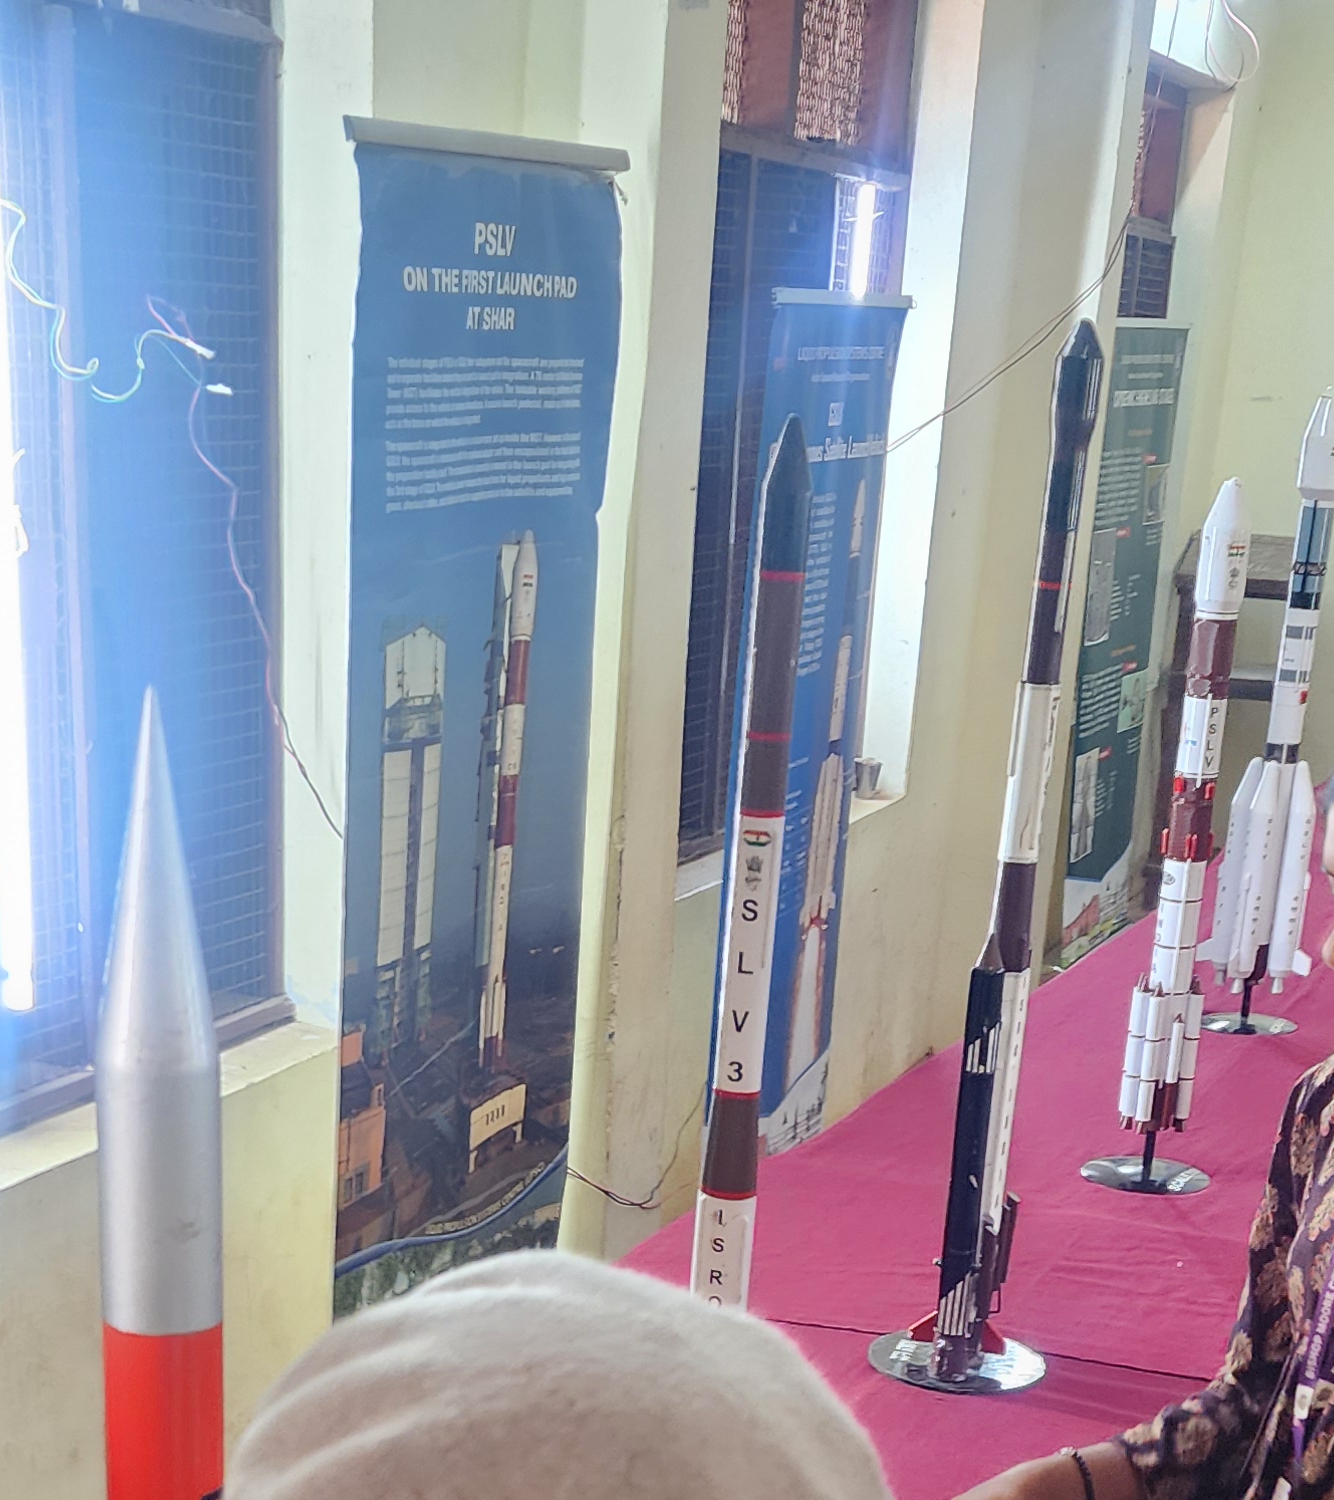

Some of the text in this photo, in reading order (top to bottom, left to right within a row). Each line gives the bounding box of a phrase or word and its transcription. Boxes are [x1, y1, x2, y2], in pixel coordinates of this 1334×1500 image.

[473, 222, 516, 257] PSLV
[403, 265, 577, 298] ON THE FIRST LAUNCH PAD
[466, 306, 515, 330] AT SHAR
